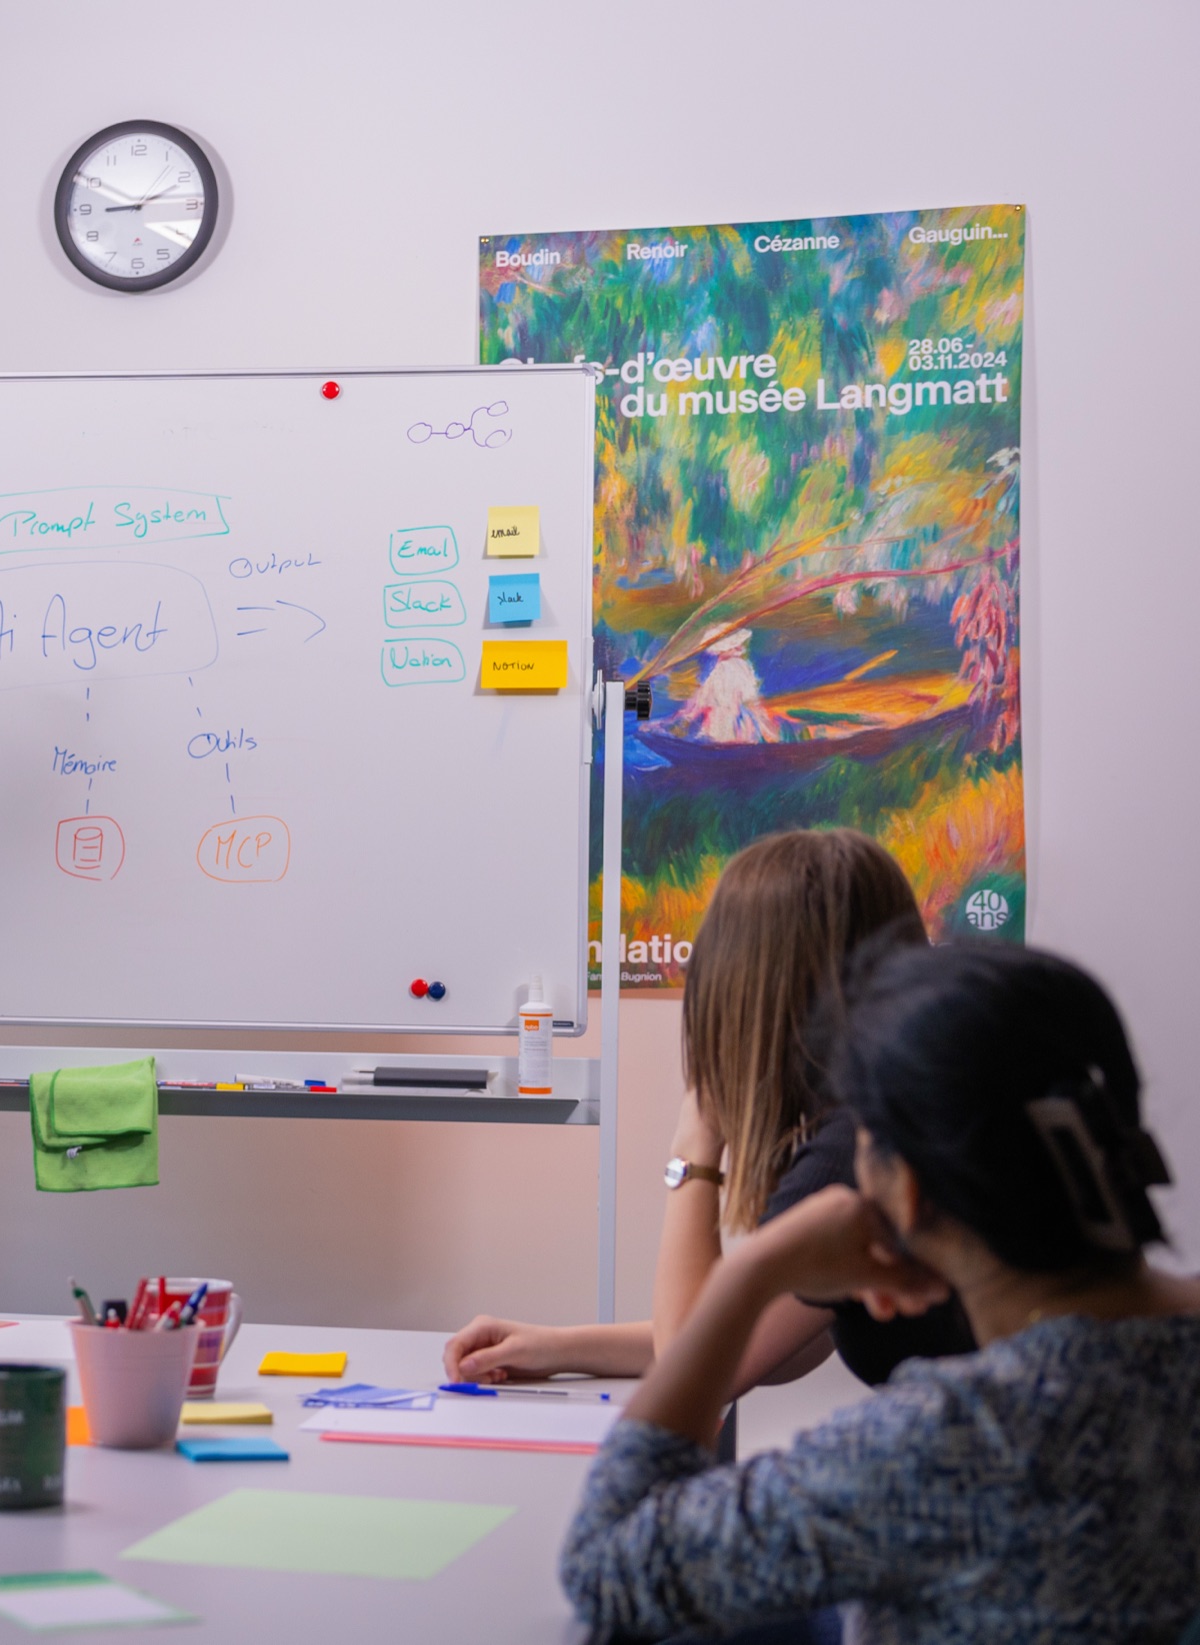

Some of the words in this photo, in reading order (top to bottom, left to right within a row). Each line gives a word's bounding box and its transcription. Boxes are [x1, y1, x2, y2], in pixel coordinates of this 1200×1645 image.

[131, 145, 147, 156] 12
[178, 171, 191, 183] 2
[79, 204, 92, 215] 9
[186, 199, 198, 210] 3
[86, 230, 99, 242] 8
[754, 233, 840, 254] Cézanne
[908, 224, 1008, 246] Gauguin...
[105, 251, 117, 267] 7
[156, 249, 170, 260] 5
[495, 249, 561, 268] Boudin
[626, 241, 688, 261] Renoir
[131, 258, 145, 269] 6
[499, 351, 777, 385] s-d’œuvre
[908, 351, 1007, 371] 03.11.2024
[620, 386, 668, 418] du
[678, 378, 806, 416] musée
[816, 372, 1008, 415] Langmatt
[115, 501, 207, 537] System
[397, 537, 448, 558] Email
[228, 553, 322, 578] Output
[390, 587, 452, 612] Slack
[41, 594, 168, 670] Agent
[187, 728, 257, 759] Outils
[53, 746, 117, 775] Mémoire
[215, 829, 272, 869] MCP
[972, 890, 1002, 911] 40
[966, 912, 1009, 928] ans
[621, 971, 662, 983] Bugnion
